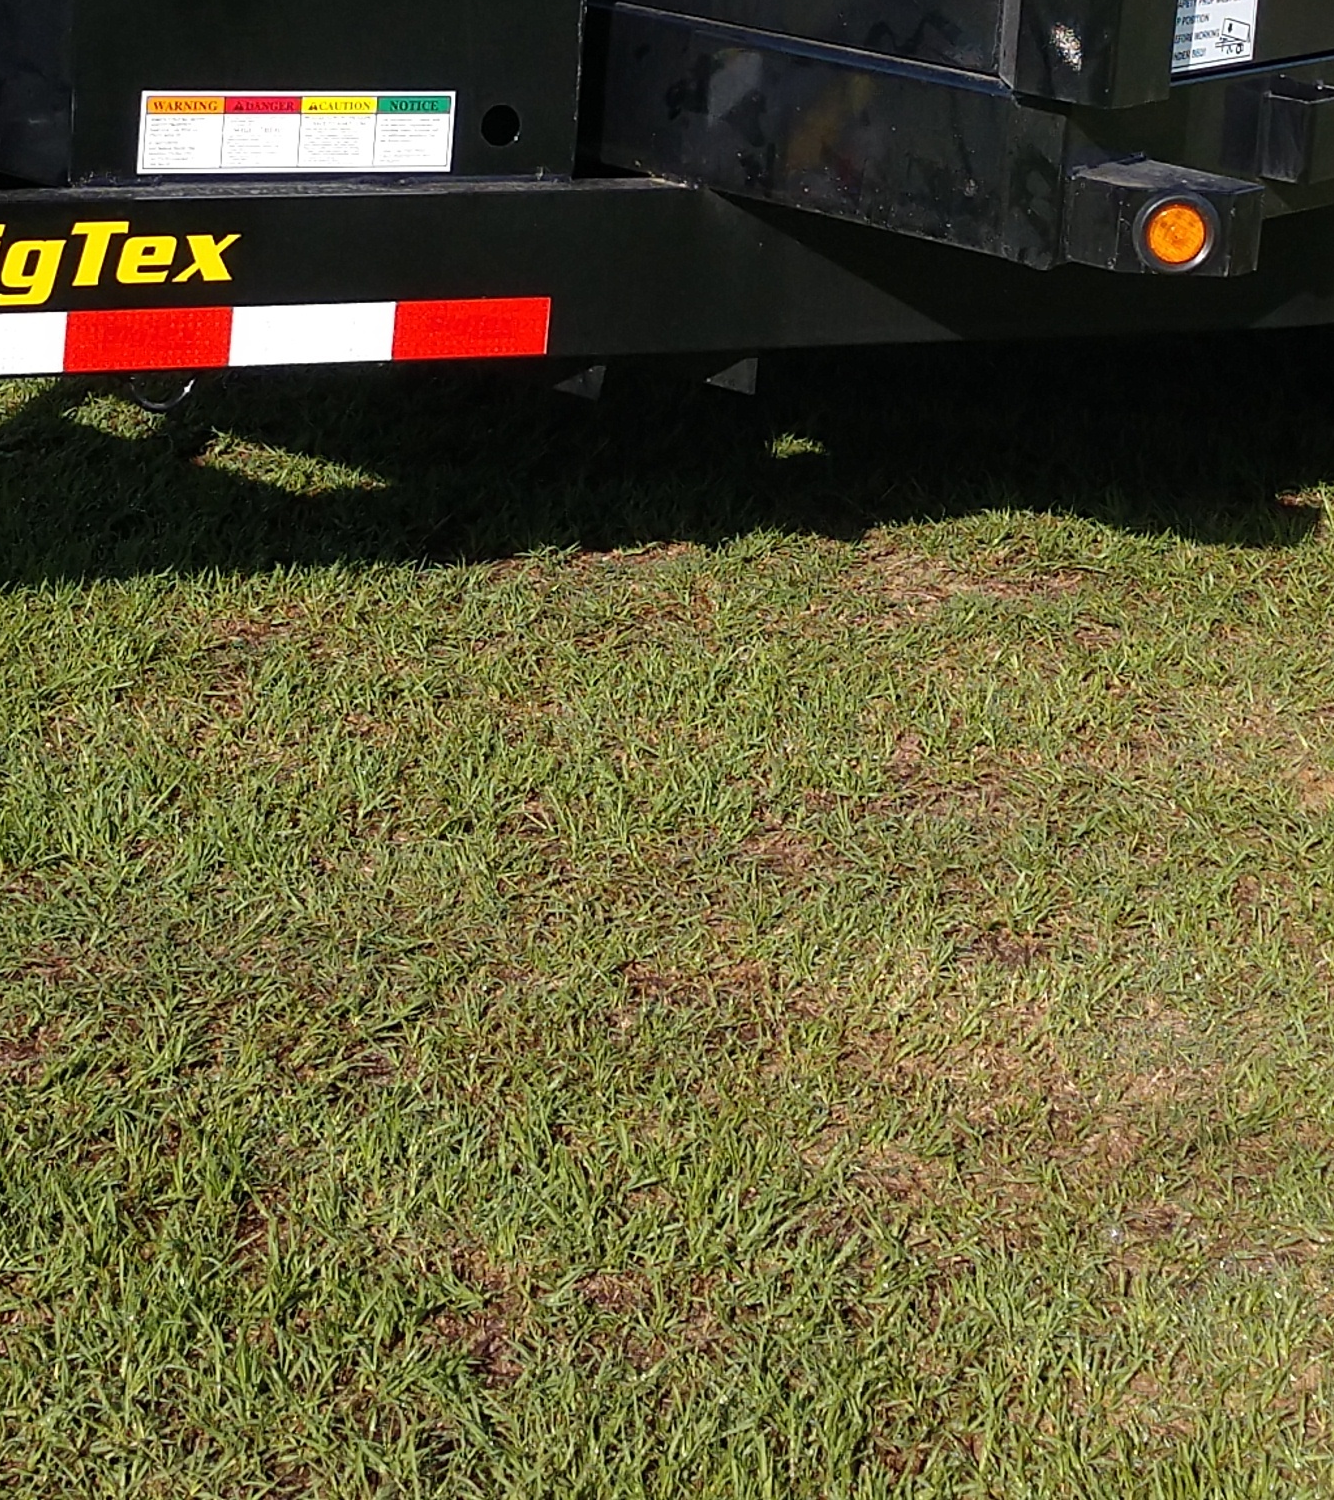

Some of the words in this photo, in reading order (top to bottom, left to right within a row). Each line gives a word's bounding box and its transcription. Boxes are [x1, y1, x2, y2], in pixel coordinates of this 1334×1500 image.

[153, 100, 217, 111] WARNING
[246, 101, 294, 111] DANGER
[320, 101, 371, 111] CAUTION
[390, 100, 439, 111] NOTICE
